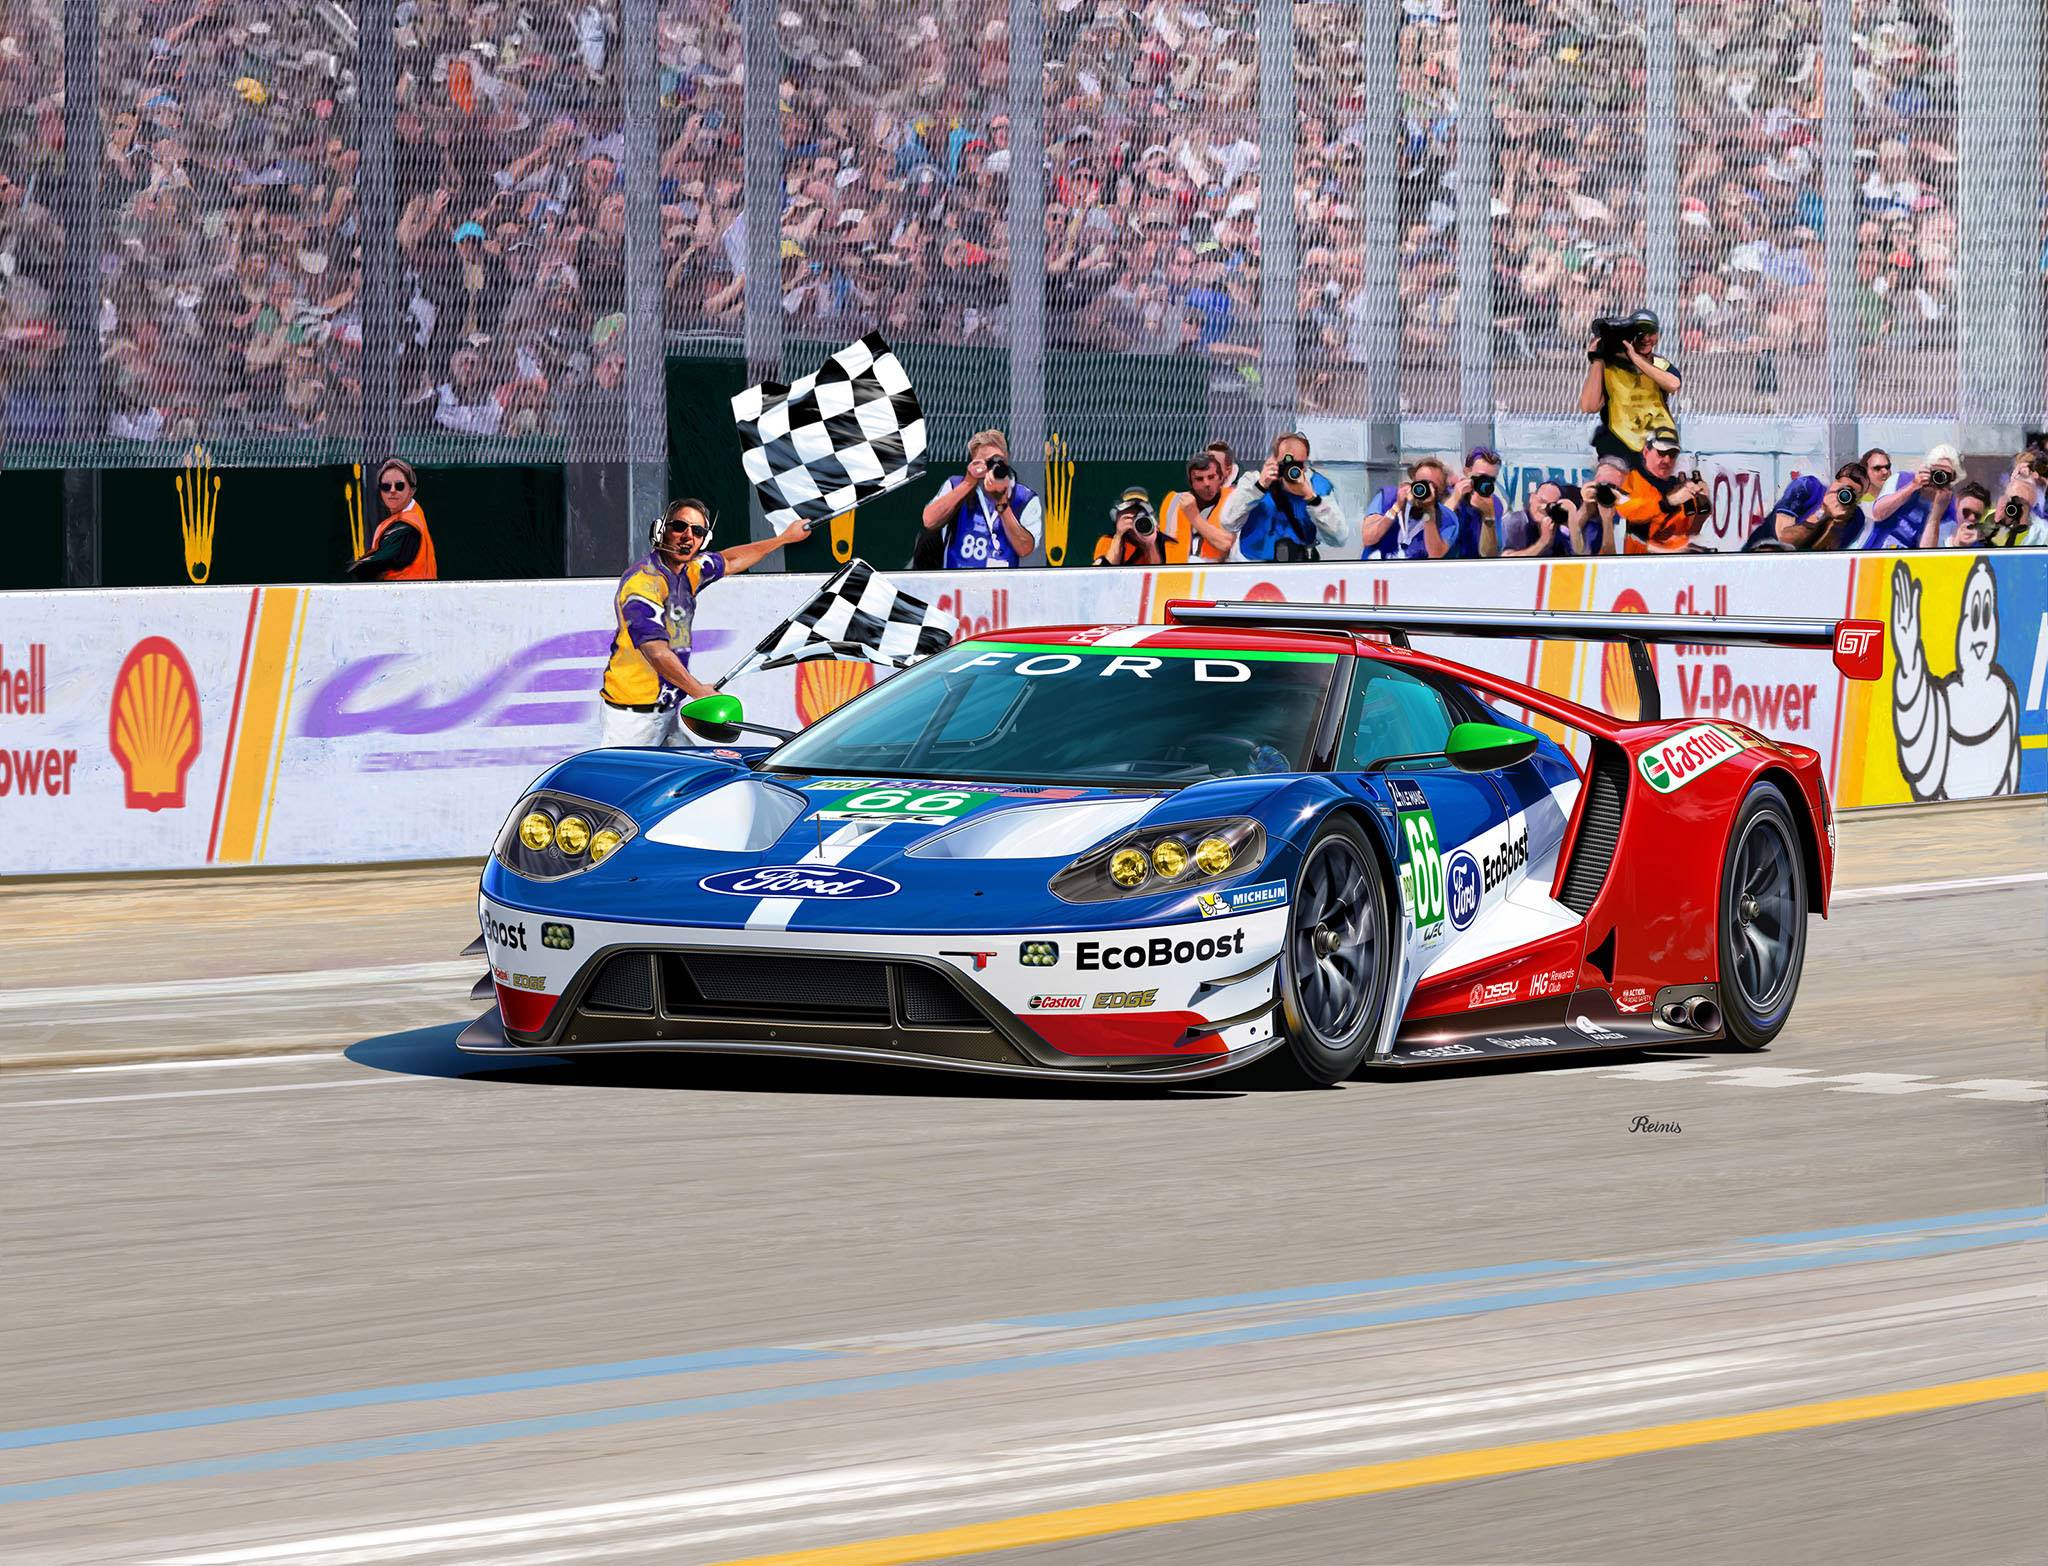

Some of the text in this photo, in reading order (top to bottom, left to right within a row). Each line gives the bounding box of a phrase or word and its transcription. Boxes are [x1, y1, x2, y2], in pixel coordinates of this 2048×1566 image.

[961, 534, 987, 560] 88
[1836, 628, 1881, 657] GT
[949, 653, 1252, 683] FORD
[1676, 664, 1818, 732] V-Power
[1662, 729, 1735, 779] Castrol
[846, 790, 971, 811] 66
[1405, 816, 1442, 920] 66
[1483, 827, 1529, 894] EcoBoost
[732, 868, 865, 895] Ford
[1232, 885, 1285, 905] MICHELIN
[1452, 863, 1476, 919] Ford
[1076, 928, 1245, 971] EcoBoost
[512, 973, 546, 991] EDGE
[1484, 980, 1519, 999] DSSV
[1529, 969, 1575, 996] IHG Rewards
[1548, 982, 1562, 994] Club
[1040, 988, 1159, 1009] Castrol EDGE
[1627, 1114, 1682, 1134] Reinis
